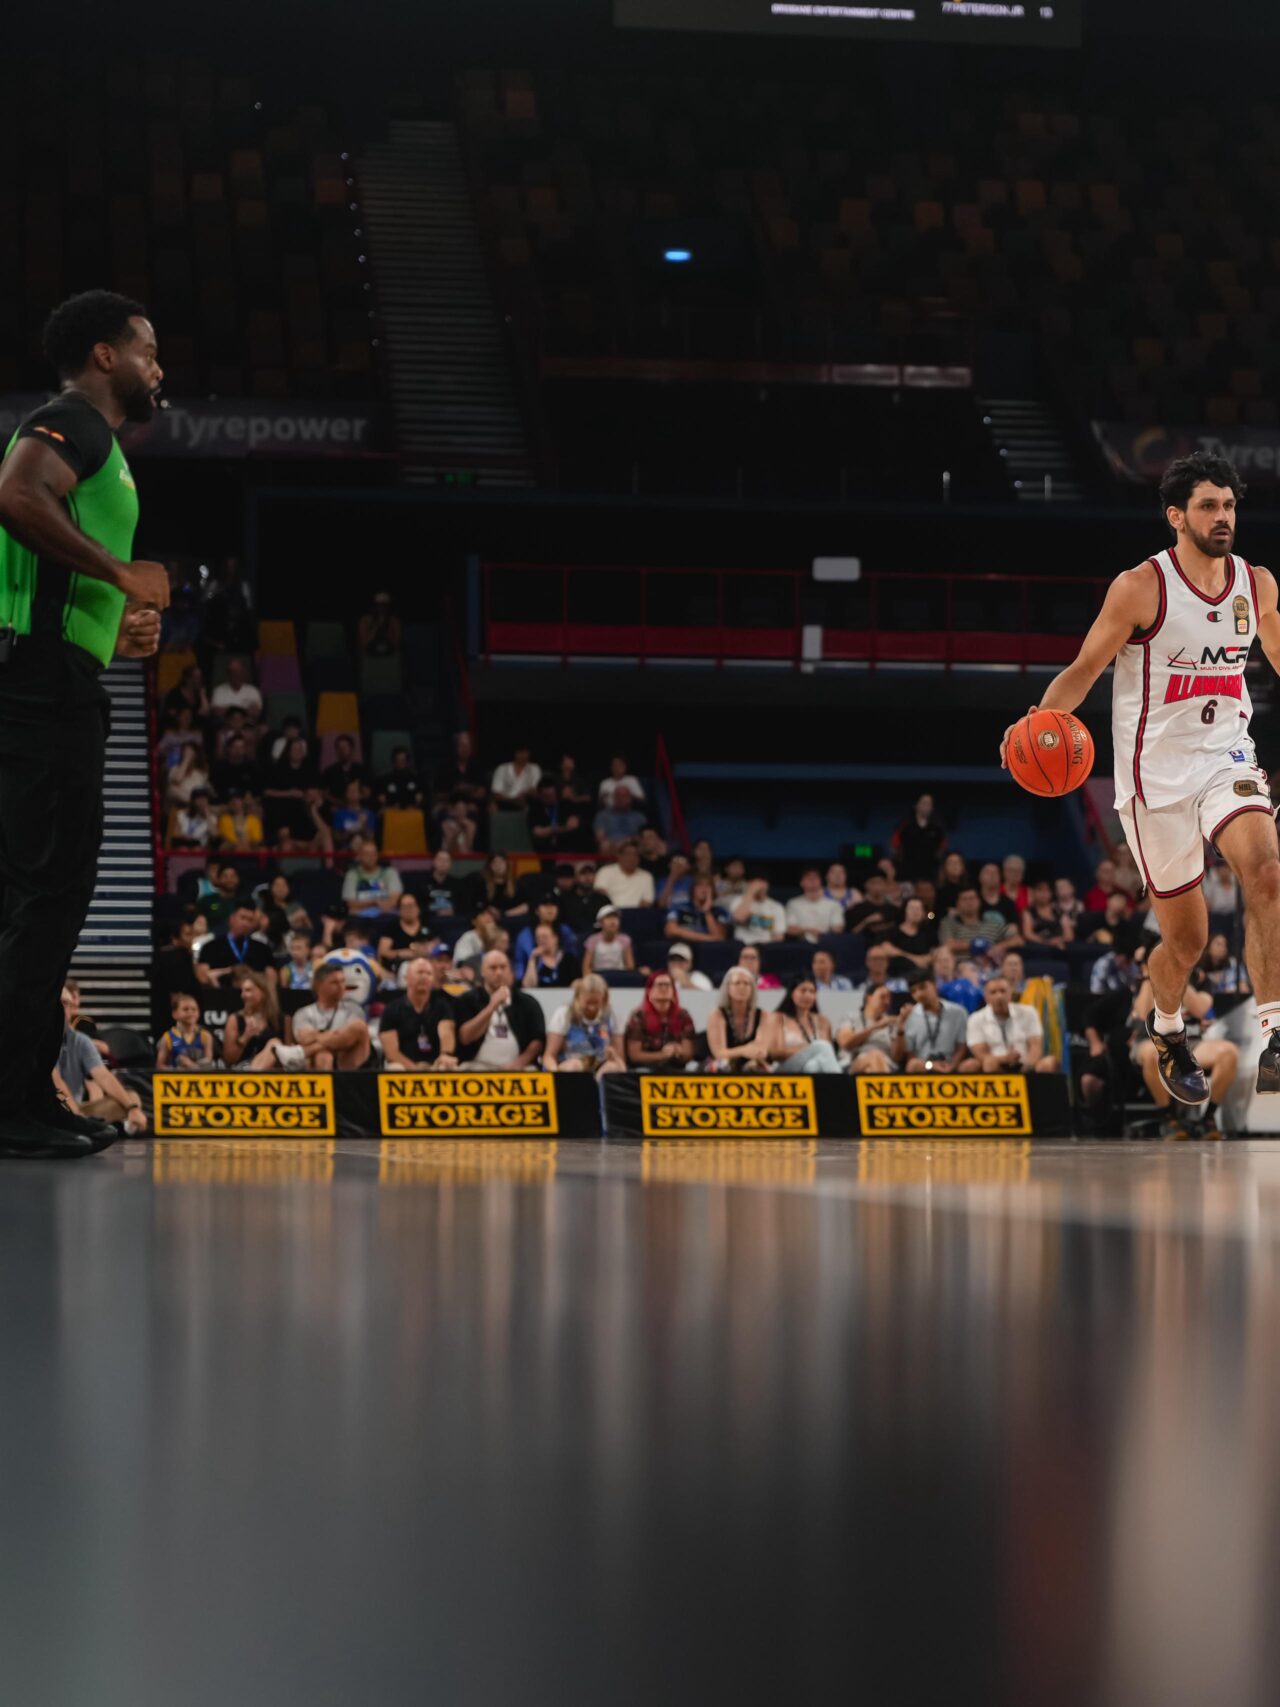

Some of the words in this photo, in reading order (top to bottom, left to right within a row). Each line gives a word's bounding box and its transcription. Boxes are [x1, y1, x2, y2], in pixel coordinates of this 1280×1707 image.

[165, 409, 367, 446] Tyrepower
[1201, 699, 1218, 725] 6
[1058, 712, 1083, 765] SPALDING
[161, 1079, 326, 1098] NATIONAL
[386, 1078, 548, 1098] NATIONAL
[648, 1081, 807, 1099] NATIONAL
[865, 1080, 1020, 1099] NATIONAL
[168, 1106, 321, 1128] STORAGE
[394, 1104, 544, 1128] STORAGE
[656, 1106, 803, 1128] STORAGE
[873, 1105, 1018, 1128] STORAGE
